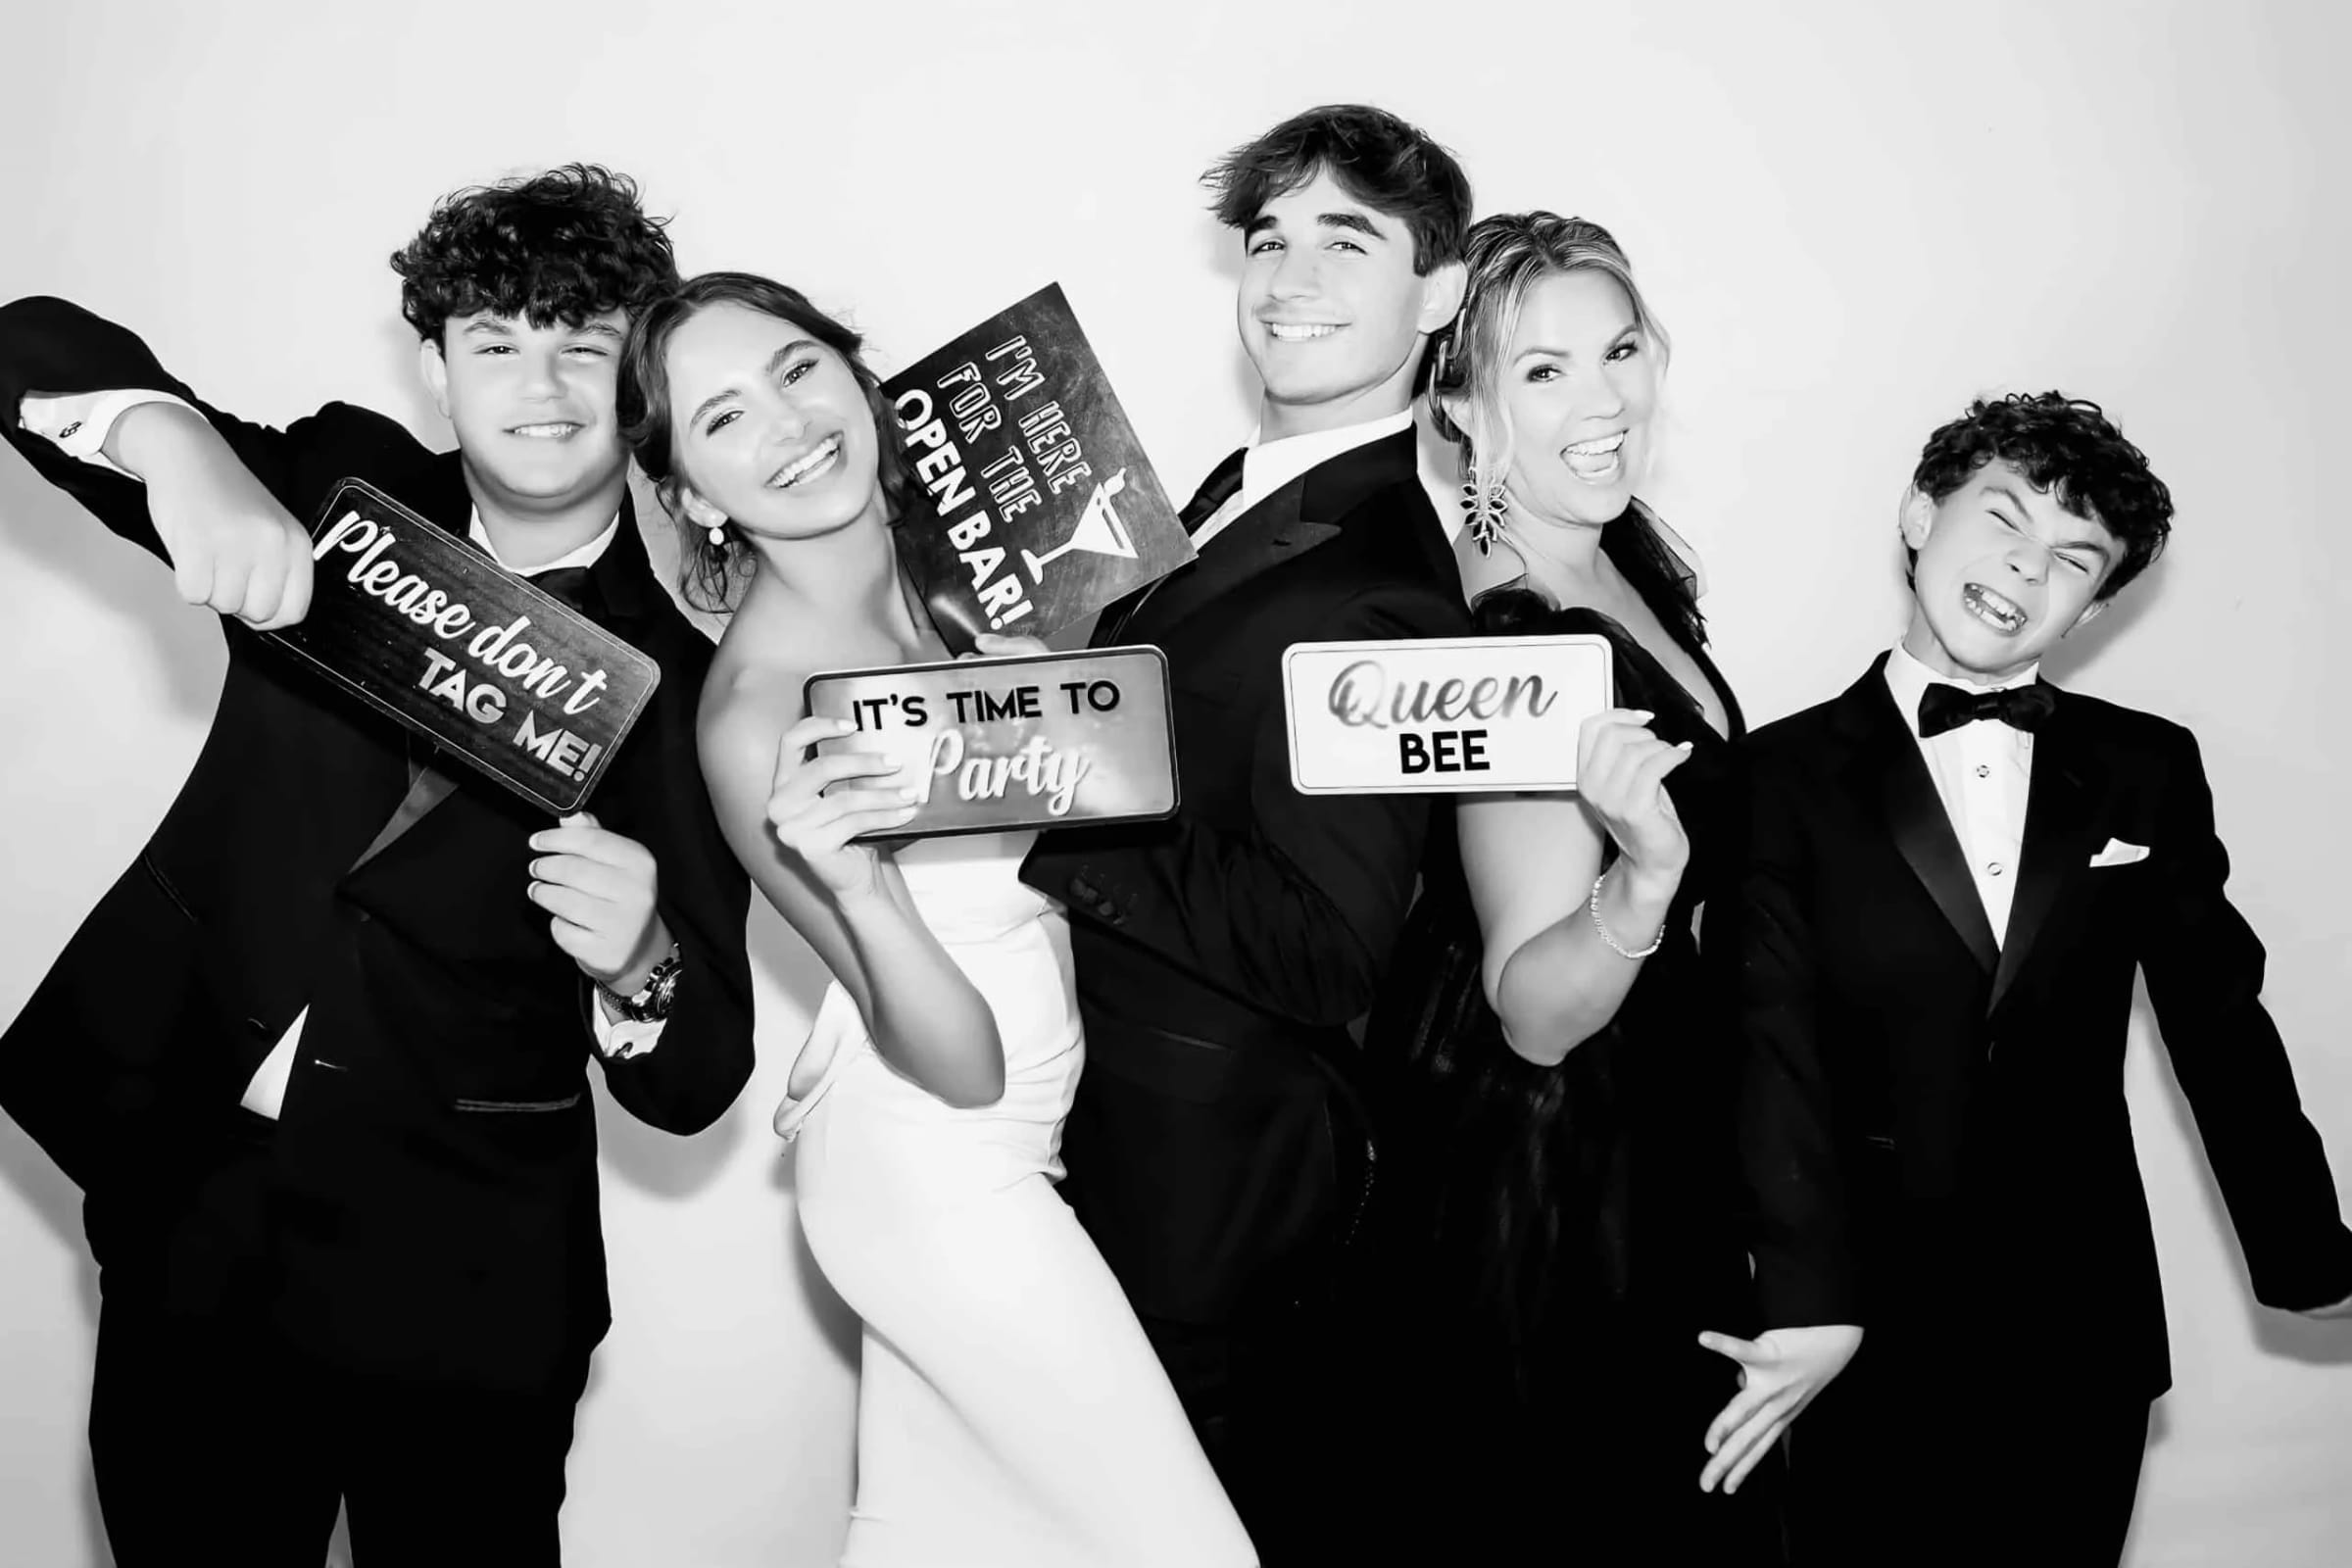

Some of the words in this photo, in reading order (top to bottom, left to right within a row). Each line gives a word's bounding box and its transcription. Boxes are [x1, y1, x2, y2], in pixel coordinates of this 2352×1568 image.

[937, 362, 1003, 444] FOR
[981, 446, 1043, 523] THE
[985, 335, 1046, 401] I'M
[1018, 400, 1093, 495] HERE
[893, 389, 977, 517] OPEN
[947, 510, 1034, 630] BAR!
[312, 511, 476, 639] Please
[417, 647, 508, 724] TAG
[513, 710, 603, 783] ME!
[853, 692, 929, 732] IT'S
[946, 686, 1043, 724] TIME
[1059, 679, 1120, 714] TO
[1328, 660, 1558, 729] Queen
[1399, 729, 1491, 774] BEE
[919, 728, 1091, 816] Party
